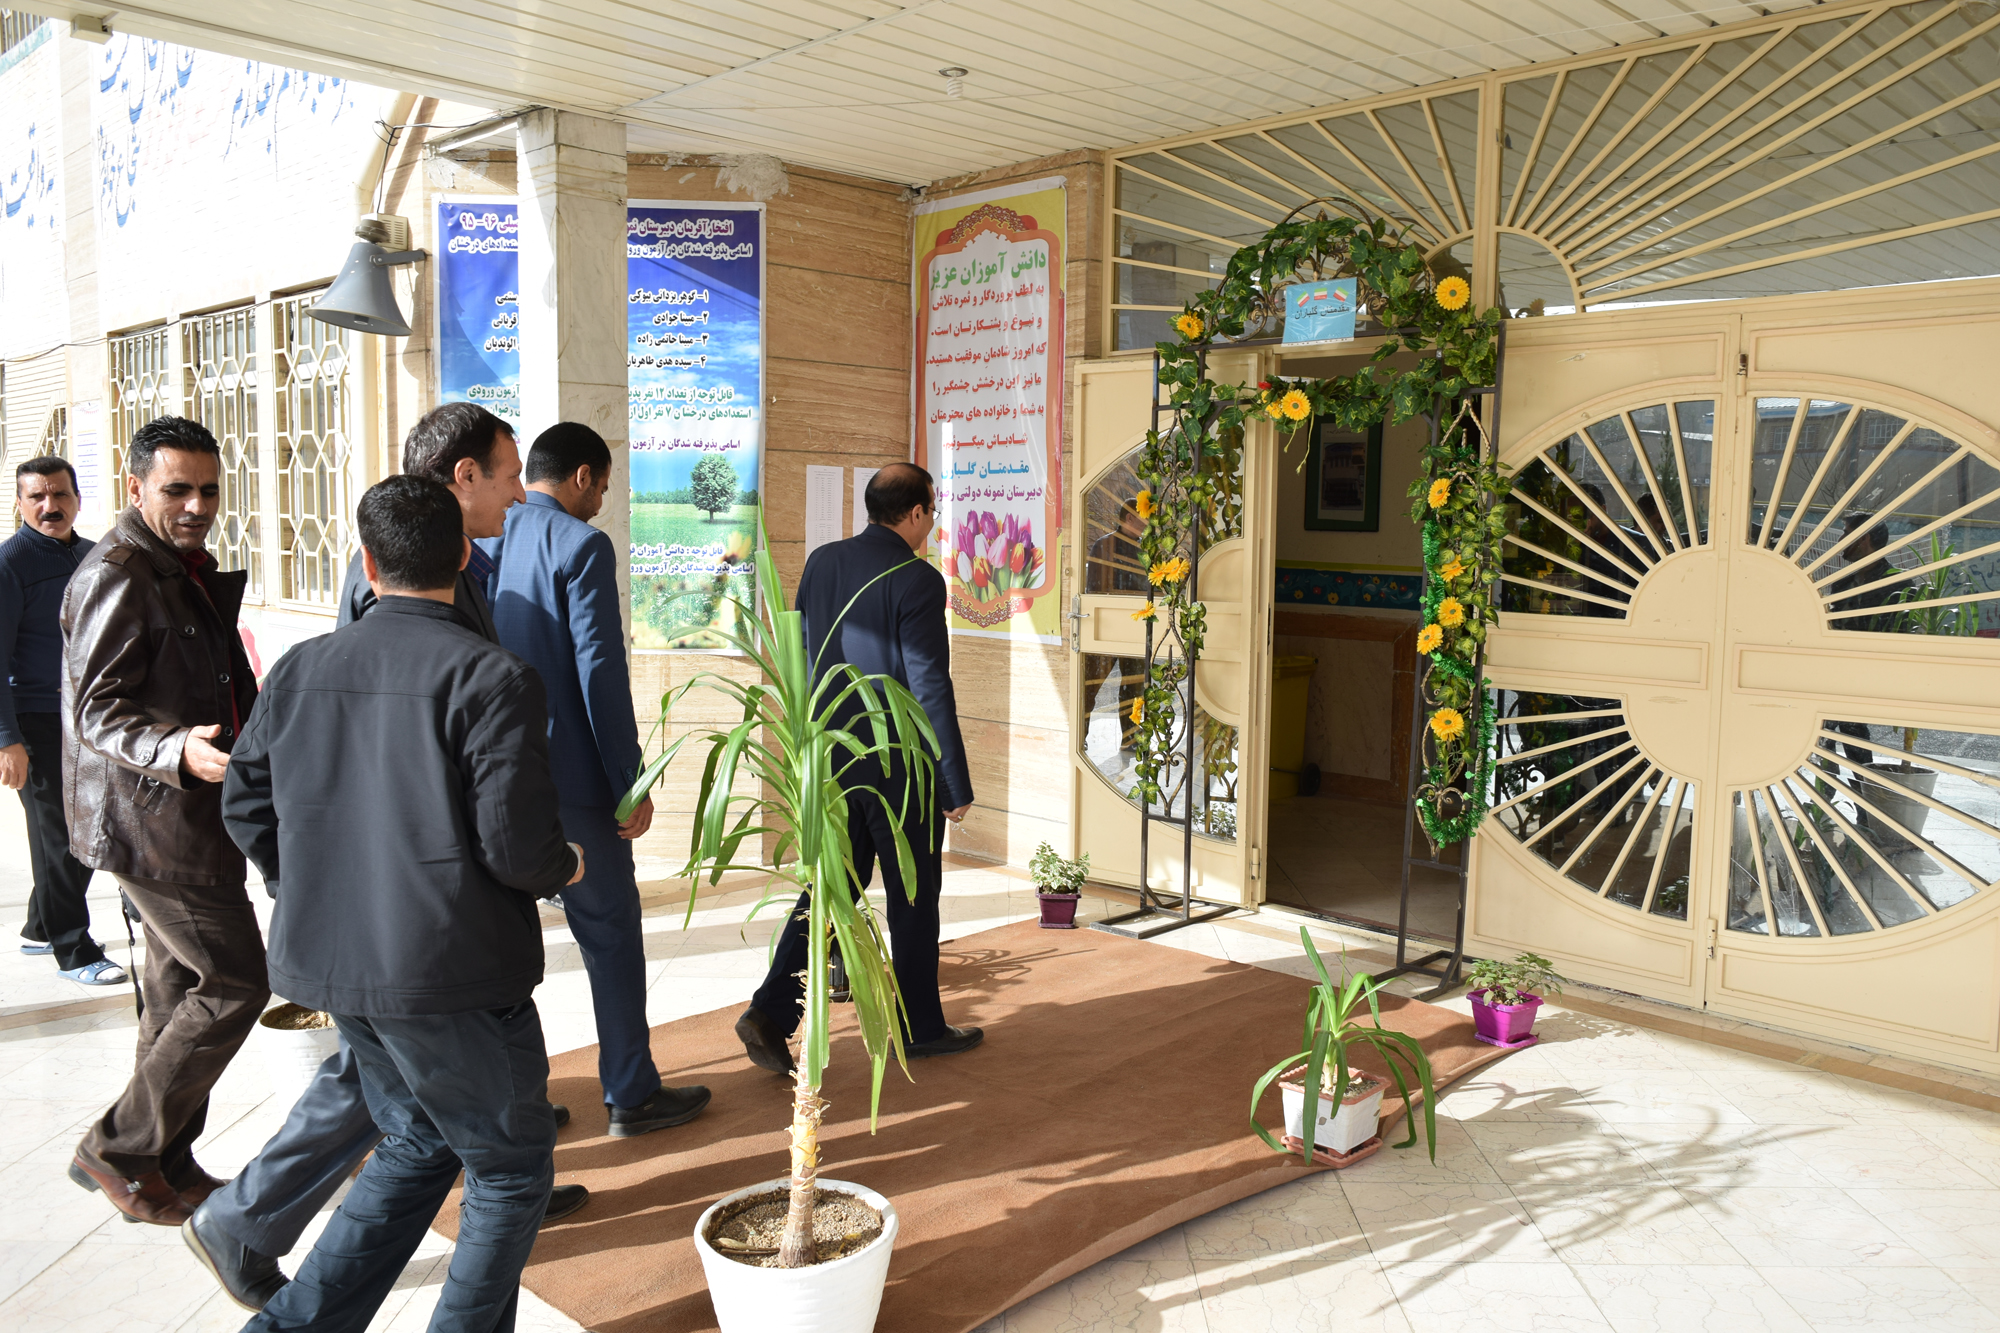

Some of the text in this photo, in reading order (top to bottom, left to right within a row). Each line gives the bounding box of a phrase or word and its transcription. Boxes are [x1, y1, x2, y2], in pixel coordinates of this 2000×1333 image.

[640, 220, 675, 235] دبیرستان
[450, 238, 479, 251] درخشان
[643, 242, 666, 256] آزمون
[666, 245, 676, 257] در
[678, 243, 701, 257] شدگان
[703, 243, 728, 258] پذیرفته
[730, 244, 751, 257] اسامی
[931, 248, 1046, 291] دانش آموزان عزیز
[496, 292, 519, 305] ستمی
[652, 288, 677, 303] یزدانی
[932, 282, 1045, 311] به لطف پروردگار و ثمره تلاش
[493, 313, 517, 328] قربانی
[654, 312, 678, 325] جوادی
[1036, 316, 1042, 328] و
[1003, 320, 1008, 331] و
[485, 337, 516, 351] الوندیان
[637, 333, 653, 346] زاده
[655, 333, 677, 346] حاتمی
[1012, 342, 1034, 360] امروز
[1036, 341, 1047, 354] که
[655, 356, 673, 368] هدی
[954, 347, 981, 364] موفقیت
[675, 357, 692, 369] سیده
[932, 372, 1042, 396] ما نیز این درخشش چشمگیر را
[469, 386, 494, 398] ورودی
[643, 387, 653, 401] نفر
[656, 387, 664, 398] ۱۲
[667, 387, 687, 399] تعداد
[689, 388, 696, 401] از
[698, 389, 715, 402] توجه
[717, 388, 733, 402] قابل
[629, 406, 636, 419] از
[638, 405, 651, 419] اول
[653, 406, 663, 420] نفر
[708, 407, 751, 420] استعدادهای
[930, 402, 1044, 424] به شما و خانواده های محترمتان
[632, 436, 655, 450] آزمون
[658, 439, 666, 451] در
[668, 438, 691, 451] شدگان
[693, 437, 717, 452] پذیرفته
[719, 439, 740, 451] اسامی
[986, 432, 1028, 449] شادباش
[979, 459, 1030, 479] مقدمتان
[956, 485, 981, 502] دولتی
[983, 484, 1005, 502] نمونه
[1006, 484, 1042, 502] دبیرستان
[637, 545, 663, 556] آموزان
[665, 546, 685, 556] دانش
[709, 546, 723, 557] قابل
[645, 561, 667, 573] آزمون
[670, 564, 679, 573] در
[705, 563, 730, 575] پذیرفته
[732, 564, 753, 574] اسامی
